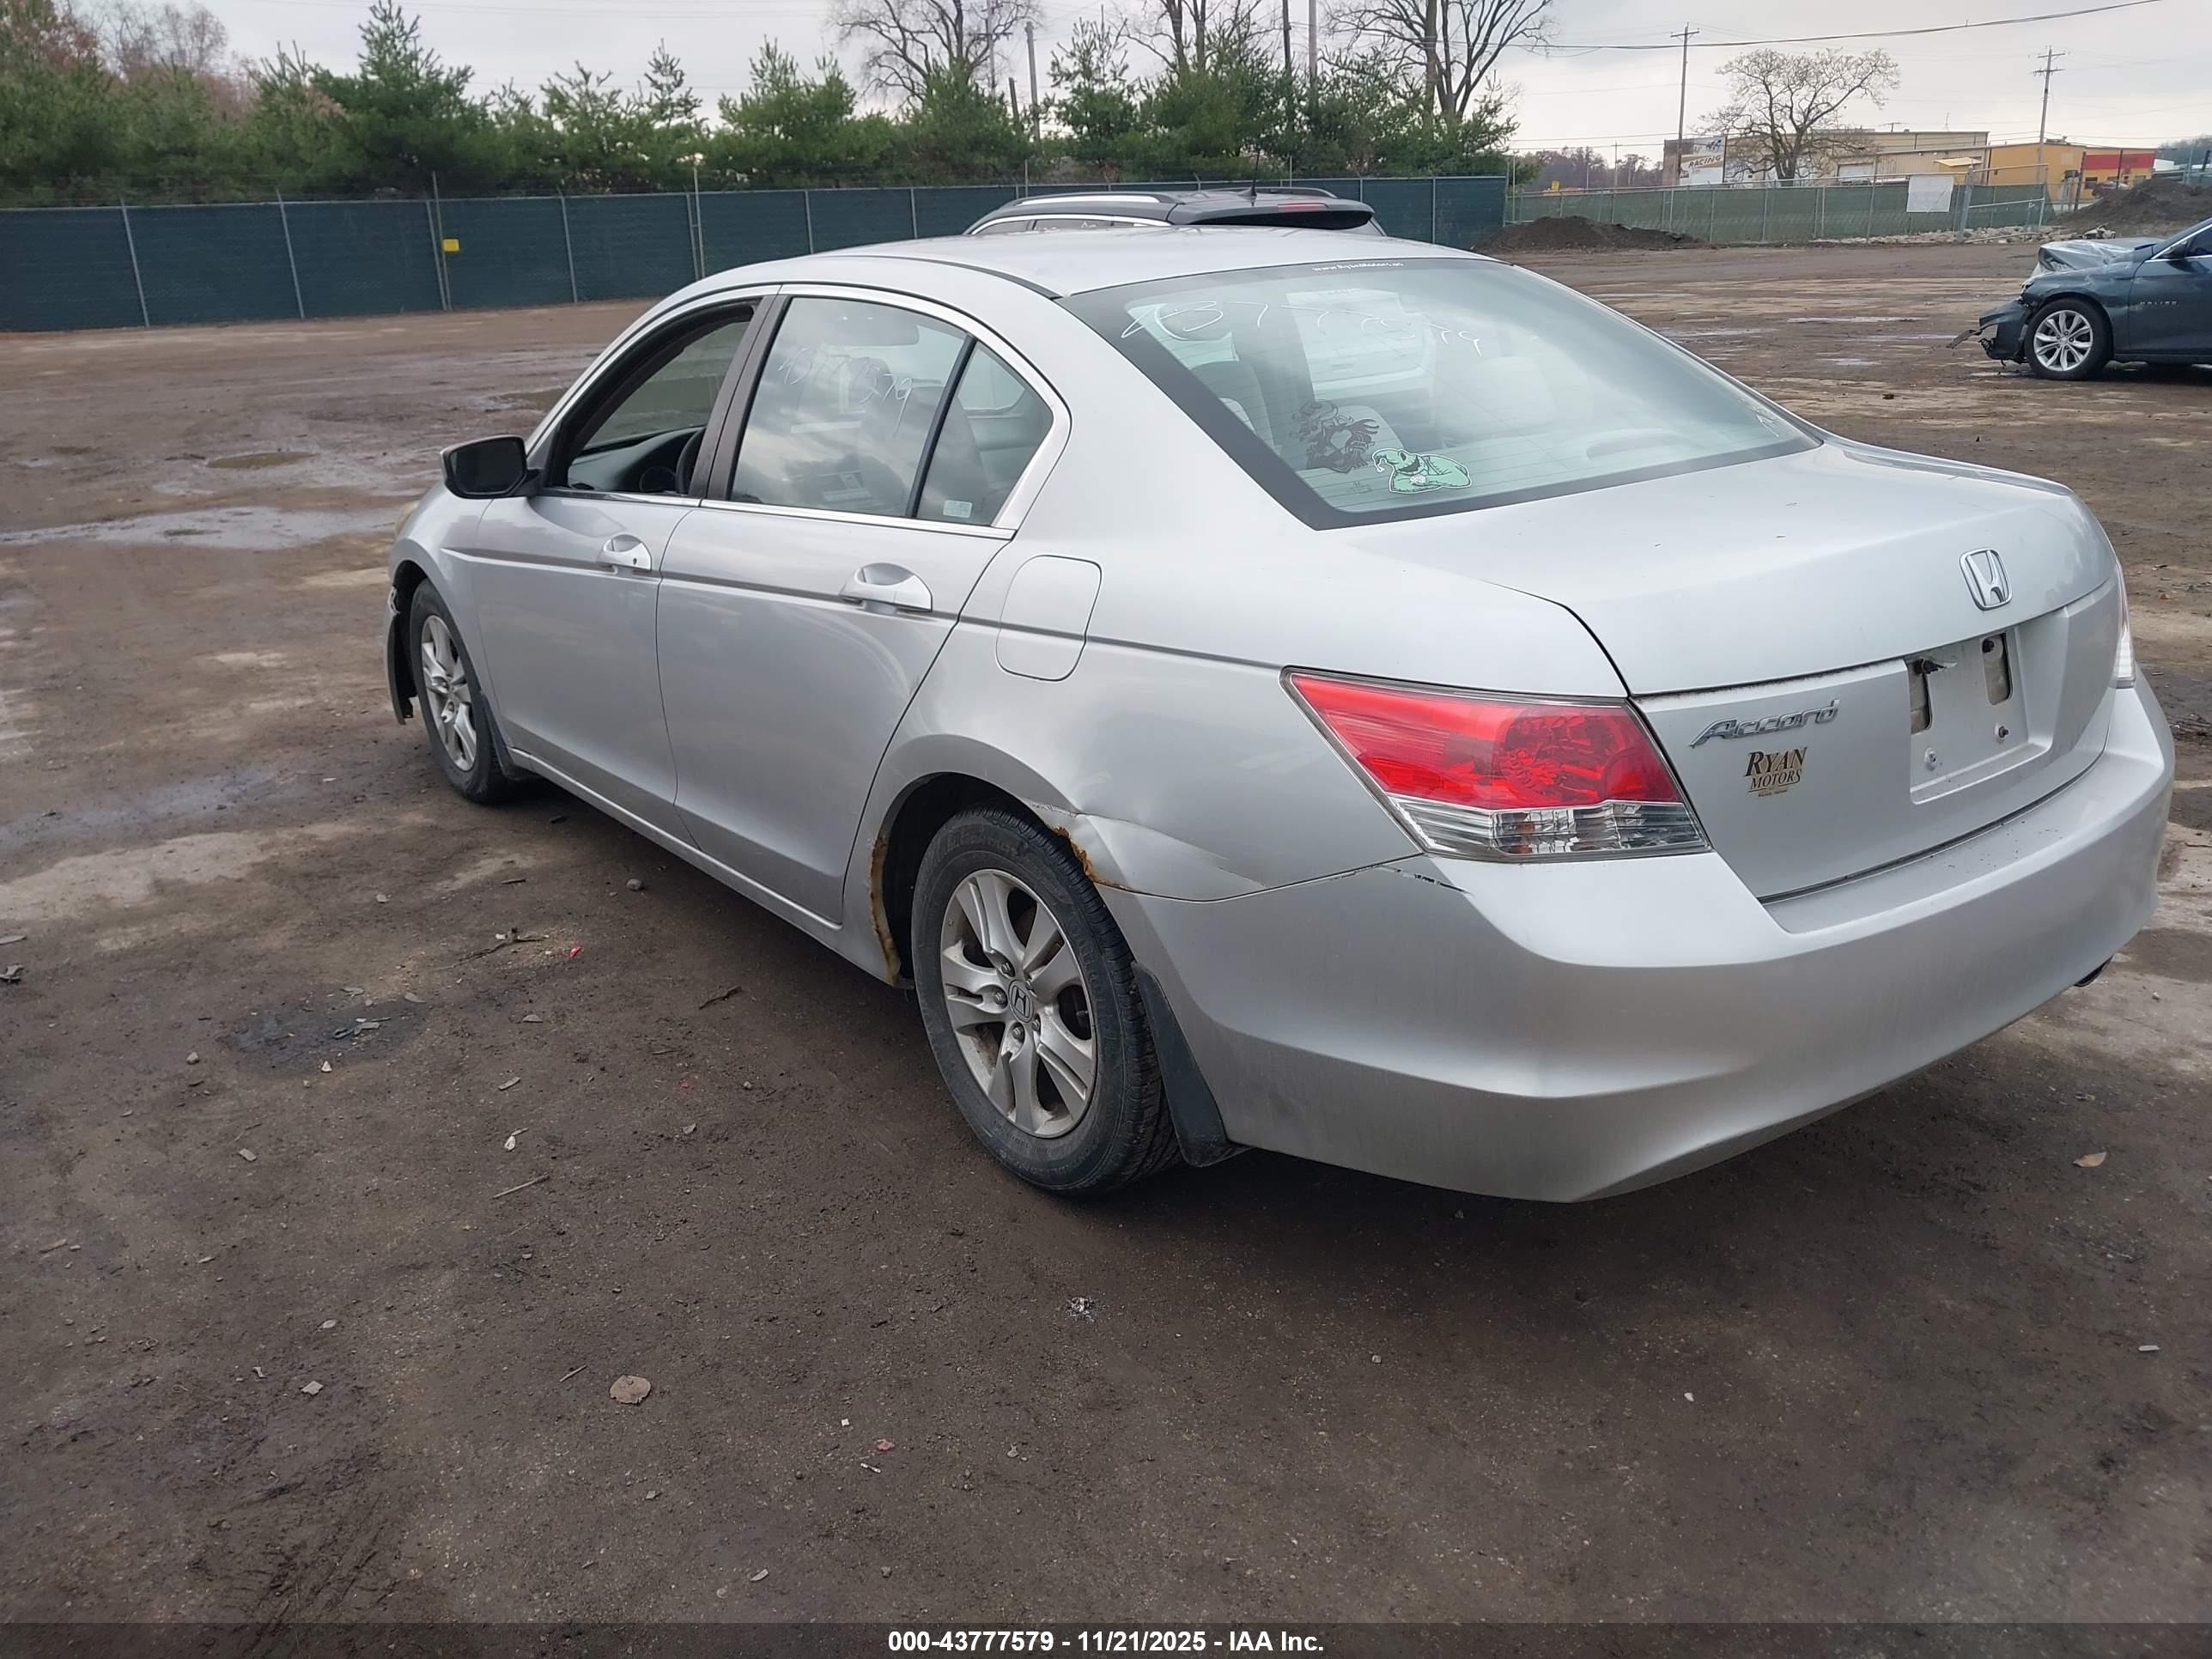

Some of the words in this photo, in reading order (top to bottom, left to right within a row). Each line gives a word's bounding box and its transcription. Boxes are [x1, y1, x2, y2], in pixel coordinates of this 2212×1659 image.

[1688, 155, 1722, 168] RACING
[1689, 698, 1840, 748] Accord
[1745, 746, 1808, 777] RYAN
[1751, 769, 1801, 790] MOTORS
